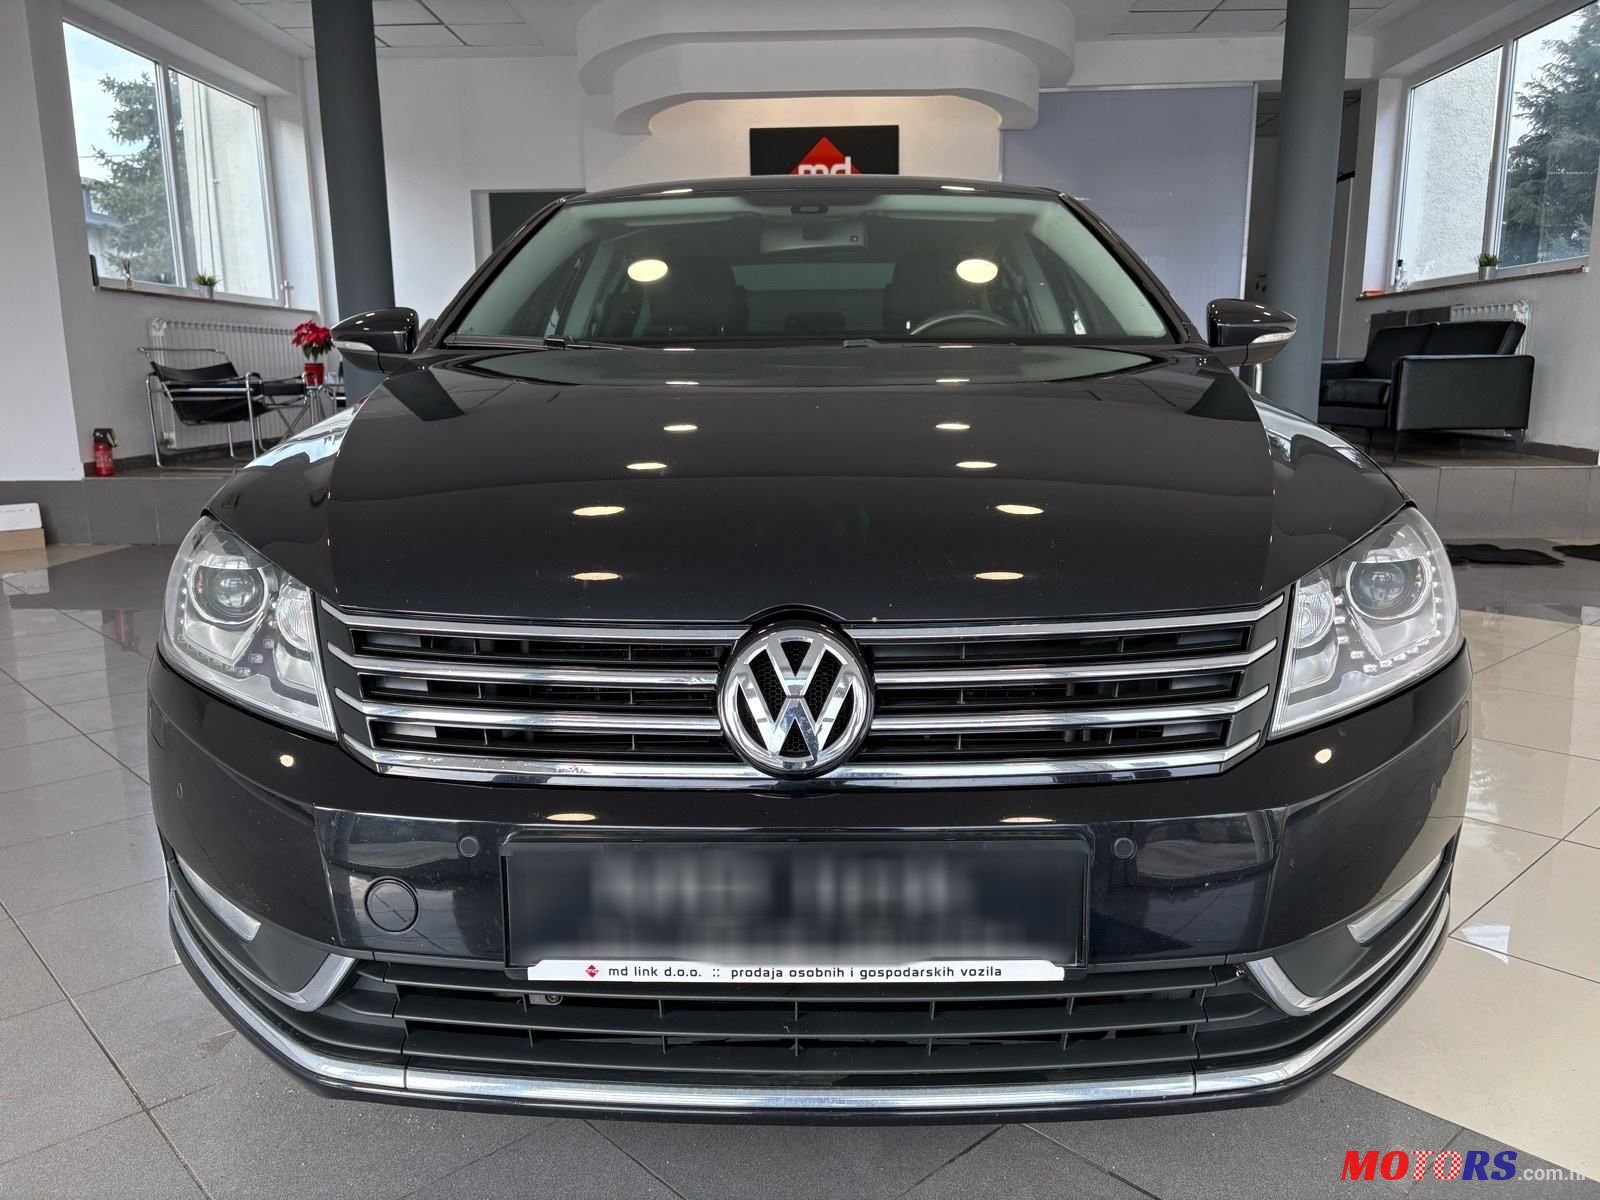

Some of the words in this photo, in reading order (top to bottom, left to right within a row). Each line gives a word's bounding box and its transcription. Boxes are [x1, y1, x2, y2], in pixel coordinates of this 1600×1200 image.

[608, 965, 628, 977] md
[634, 965, 658, 977] link
[664, 966, 702, 977] d.o.o.
[731, 967, 783, 980] prodaja
[789, 967, 845, 978] osobnih
[860, 966, 955, 980] gospodarskih
[960, 965, 1002, 977] vozila
